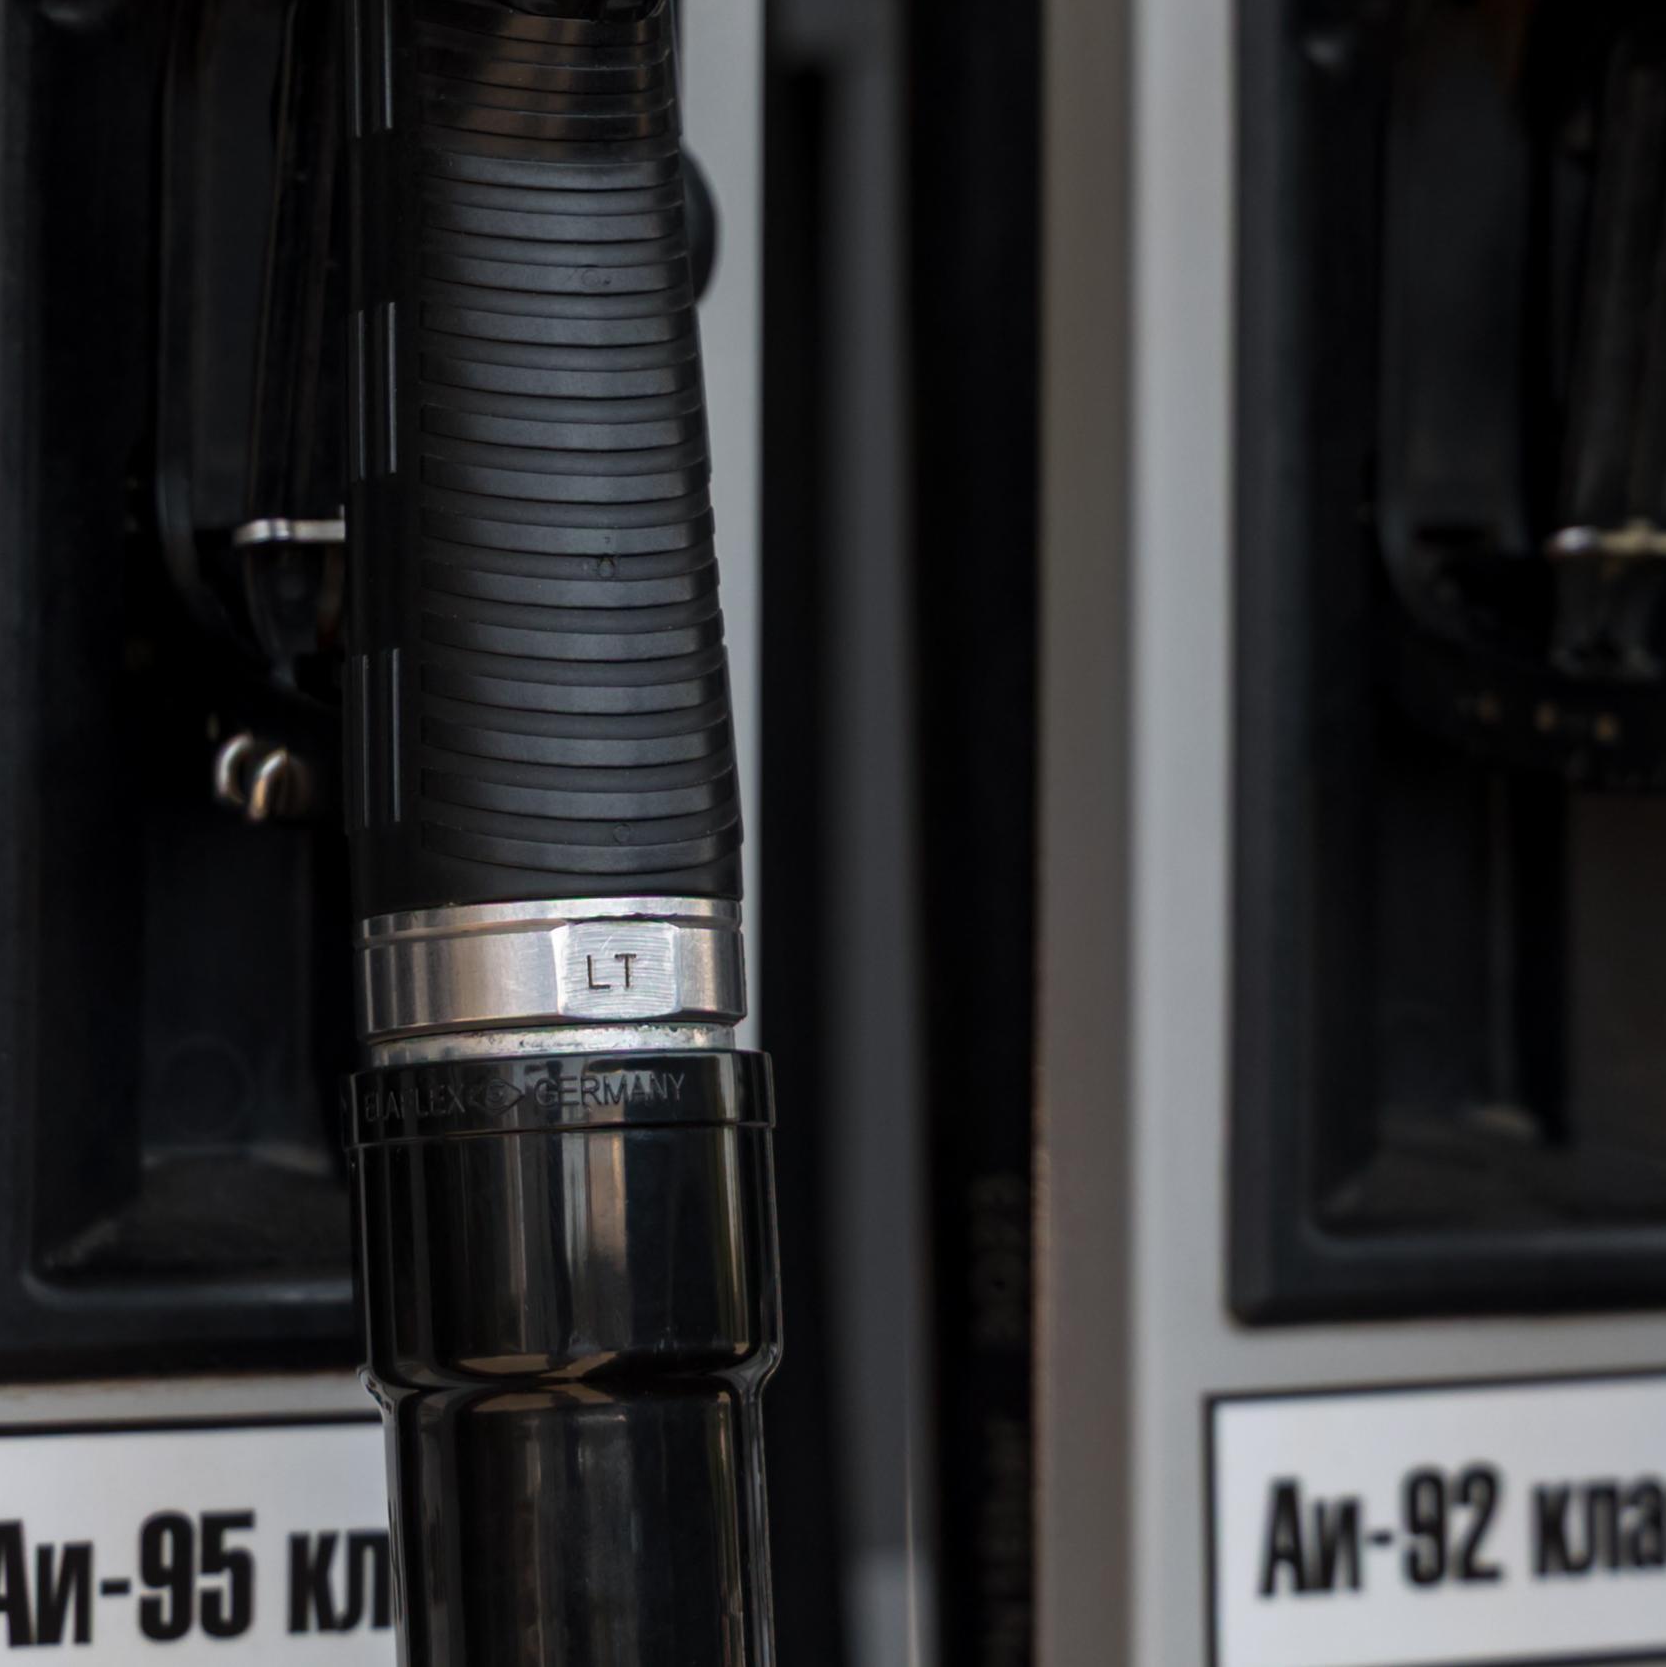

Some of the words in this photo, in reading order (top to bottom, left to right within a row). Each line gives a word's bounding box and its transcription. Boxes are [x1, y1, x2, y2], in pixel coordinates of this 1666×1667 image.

[586, 952, 638, 991] LT
[535, 1072, 686, 1109] GERMANY
[1259, 1459, 1503, 1599] Аи-92
